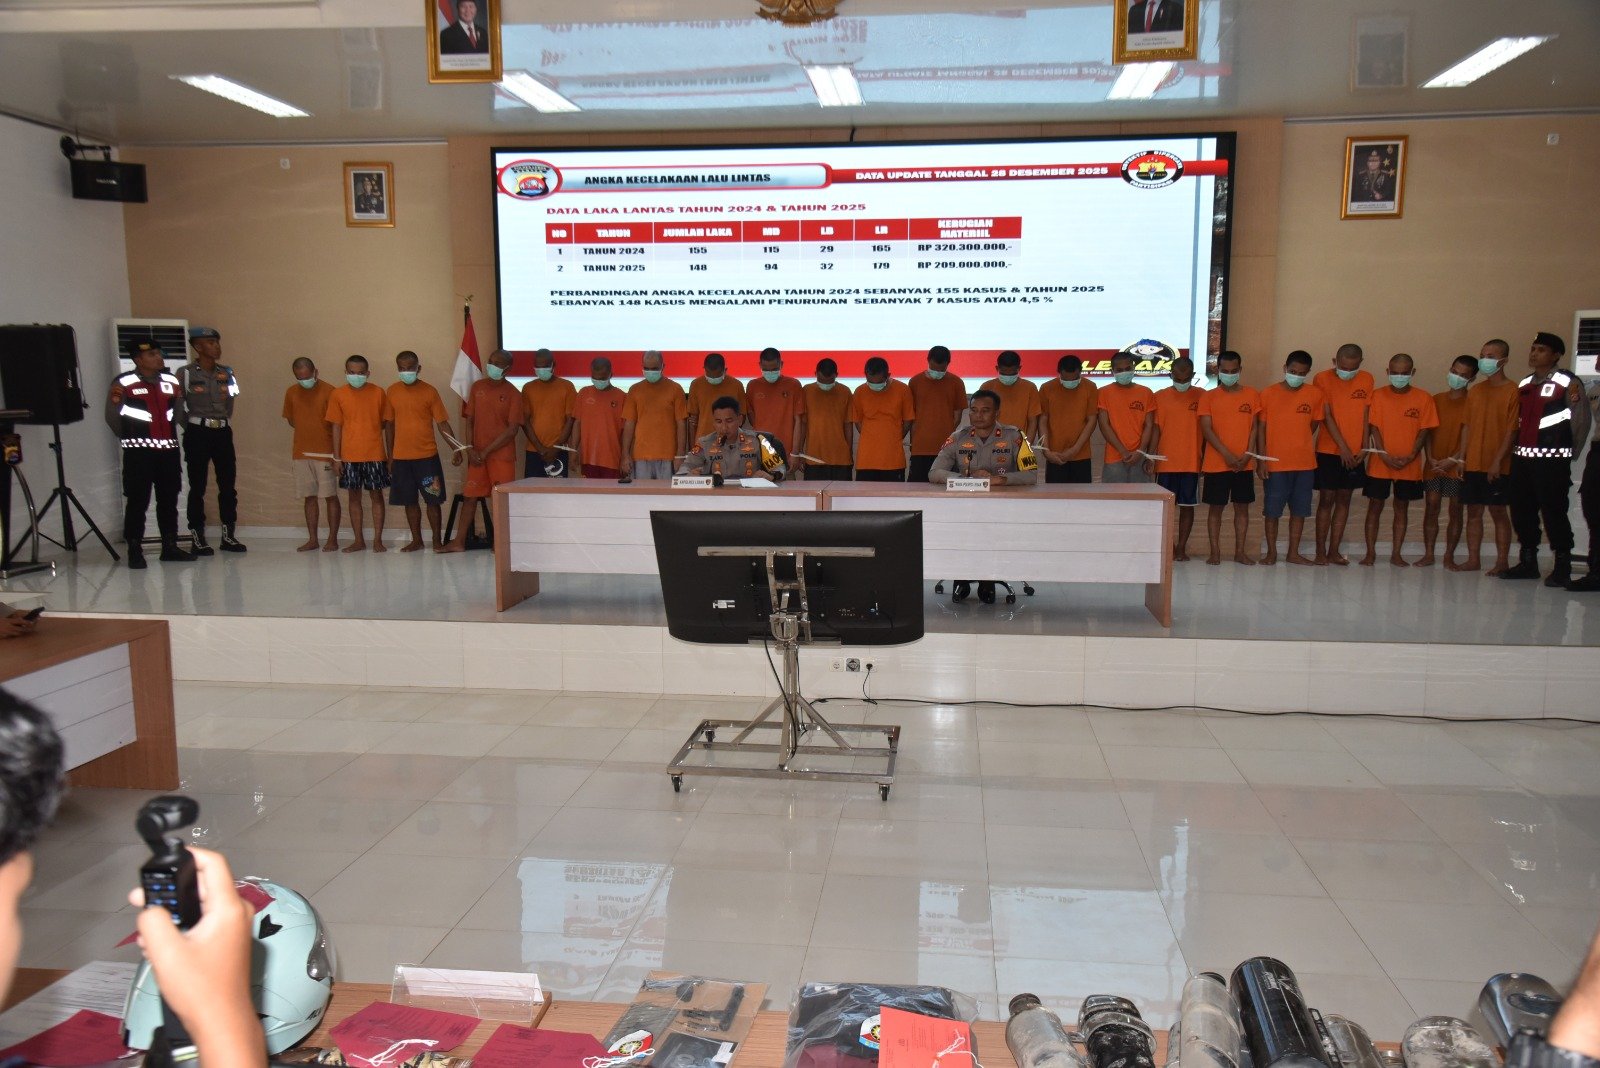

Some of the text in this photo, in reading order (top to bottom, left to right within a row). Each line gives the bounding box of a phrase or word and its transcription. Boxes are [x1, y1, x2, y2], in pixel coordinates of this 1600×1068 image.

[855, 166, 1109, 179] DATA UPDATE TANGGAL 28 DESEMBER 2025
[584, 173, 771, 185] ANGKA KECELAKAAN LALU LINTAS
[937, 218, 993, 229] KERUGIAN
[596, 228, 631, 237] TAHUN
[662, 227, 733, 237] JUMLAH LAKA
[762, 227, 780, 236] MD
[940, 229, 990, 238] MATERIIL
[582, 247, 616, 255] TAHUN
[688, 246, 707, 254] 155
[763, 245, 780, 253] 115
[871, 244, 891, 252] 165
[582, 264, 616, 272] TAHUN
[689, 263, 707, 271] 148
[698, 288, 780, 296] KECELAKAAN
[768, 297, 848, 305] PENURUNAN
[936, 296, 981, 304] KASUS
[1019, 296, 1040, 304] 4,5
[1081, 360, 1174, 372] LEAK
